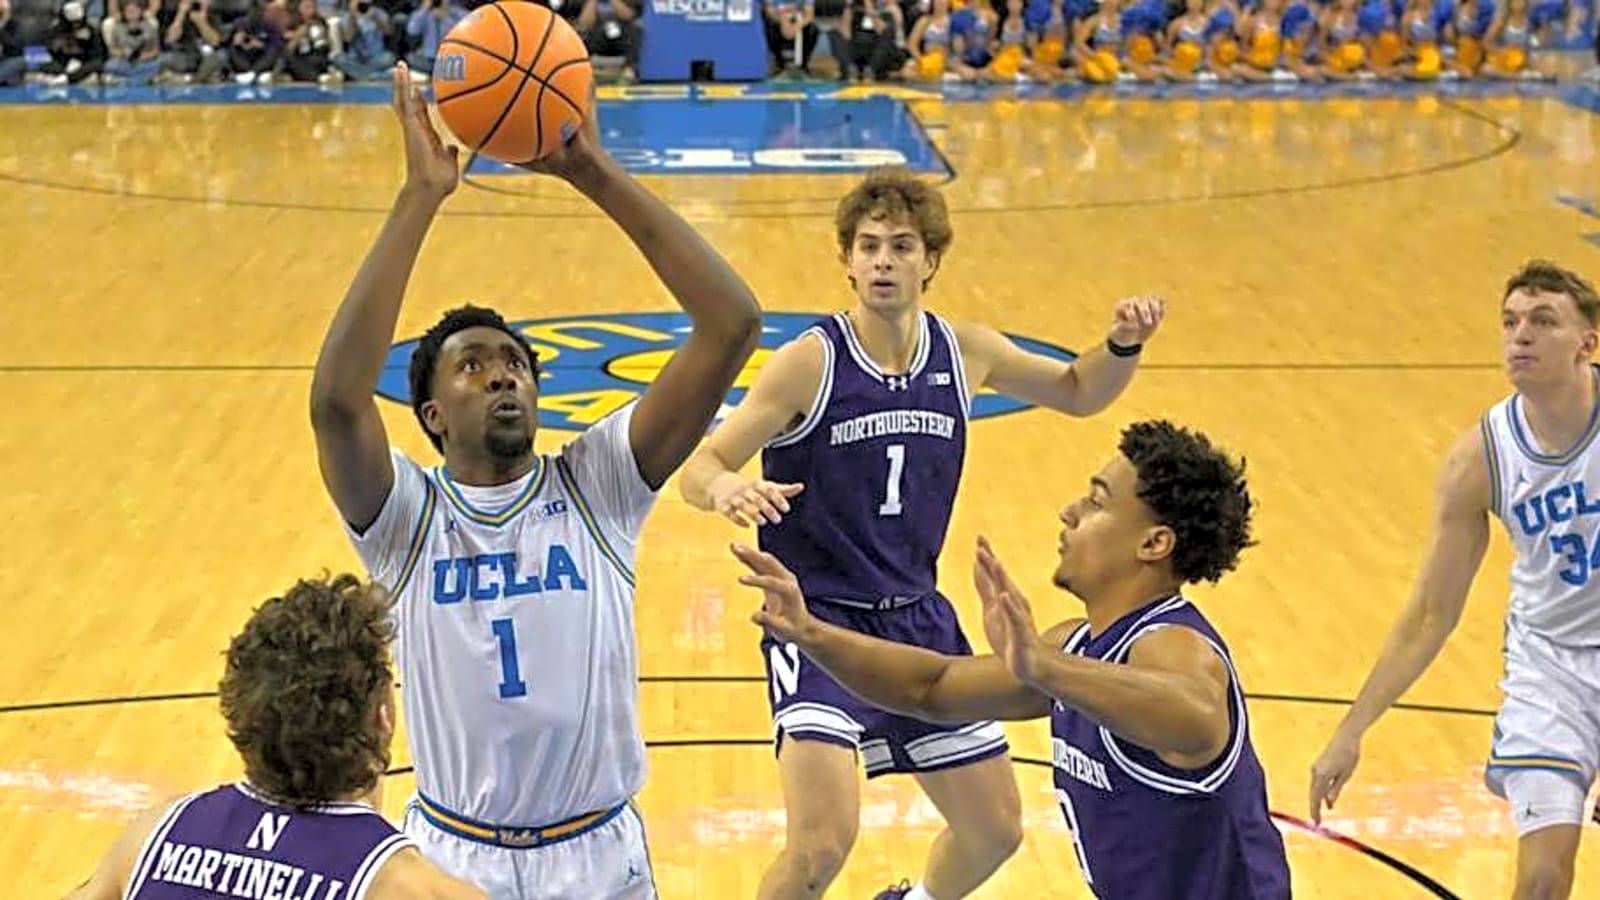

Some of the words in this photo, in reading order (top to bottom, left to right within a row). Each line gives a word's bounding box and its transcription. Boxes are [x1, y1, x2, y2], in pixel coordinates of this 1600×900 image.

[829, 410, 956, 446] NORTHWESTERN
[879, 444, 905, 516] 1
[432, 544, 588, 605] UCLA
[491, 618, 527, 699] 1
[770, 643, 799, 703] N
[246, 812, 292, 852] N
